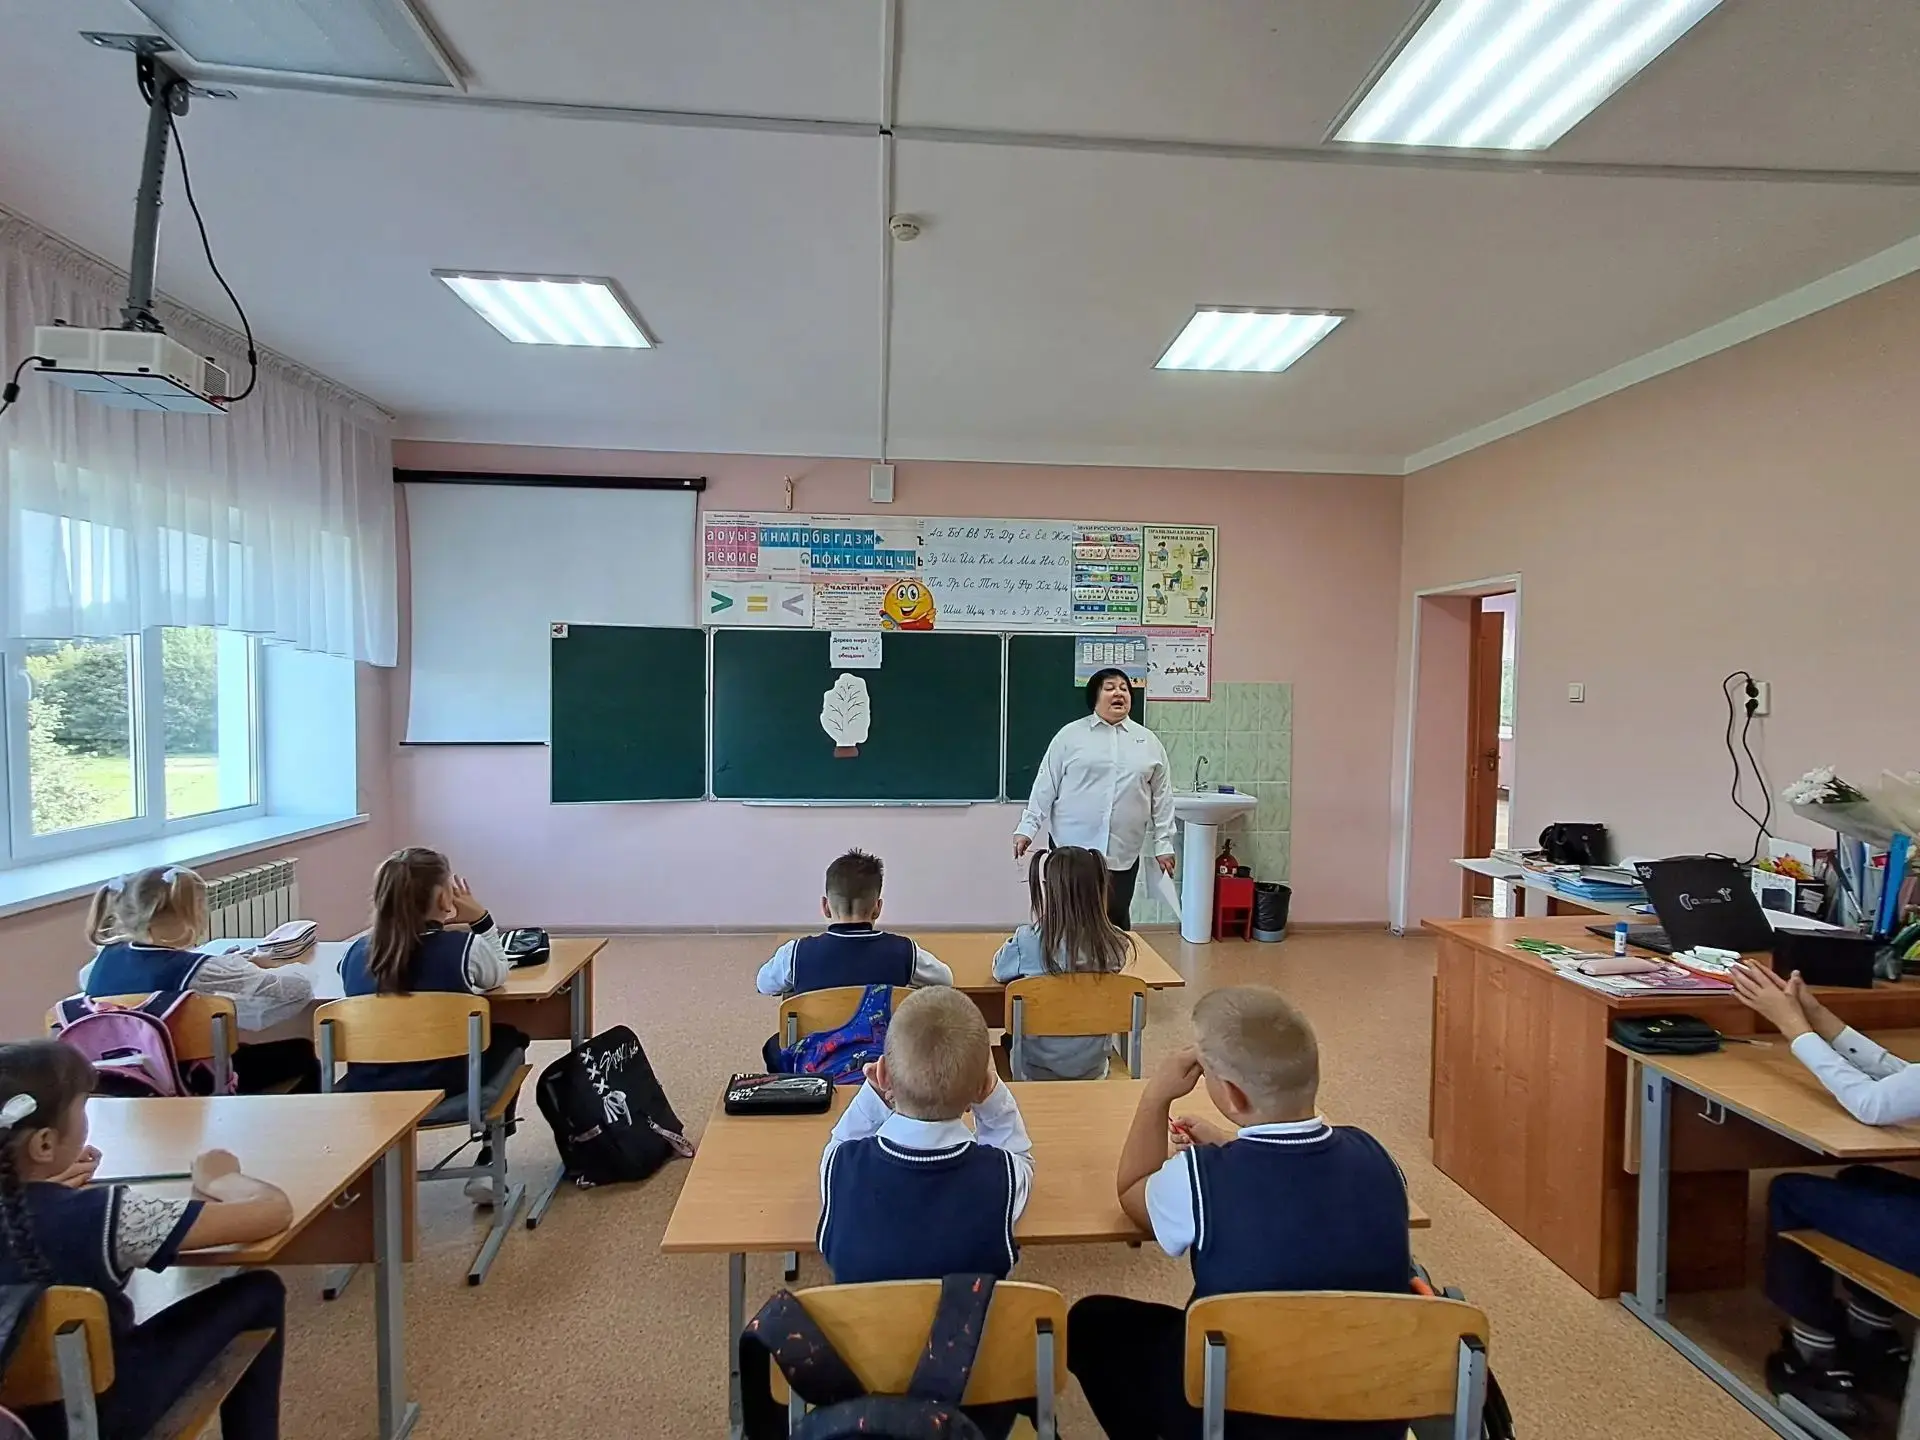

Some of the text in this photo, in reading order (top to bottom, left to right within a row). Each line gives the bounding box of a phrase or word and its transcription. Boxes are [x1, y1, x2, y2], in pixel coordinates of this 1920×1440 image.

[928, 527, 943, 538] Аа
[947, 527, 964, 539] Бб
[966, 527, 980, 539] Вв
[999, 529, 1014, 543] Дд
[1051, 530, 1071, 541] Жж
[941, 553, 956, 564] Ии
[978, 553, 994, 565] Кк
[998, 553, 1014, 565] Лл
[1017, 554, 1036, 566] Мм
[1039, 554, 1055, 566] Нн
[963, 577, 975, 589] Сс
[978, 577, 1000, 589] Тт
[1003, 578, 1015, 593] Уу
[1035, 580, 1051, 591] Хх
[943, 603, 962, 614] Шш
[966, 604, 985, 616] Щщ
